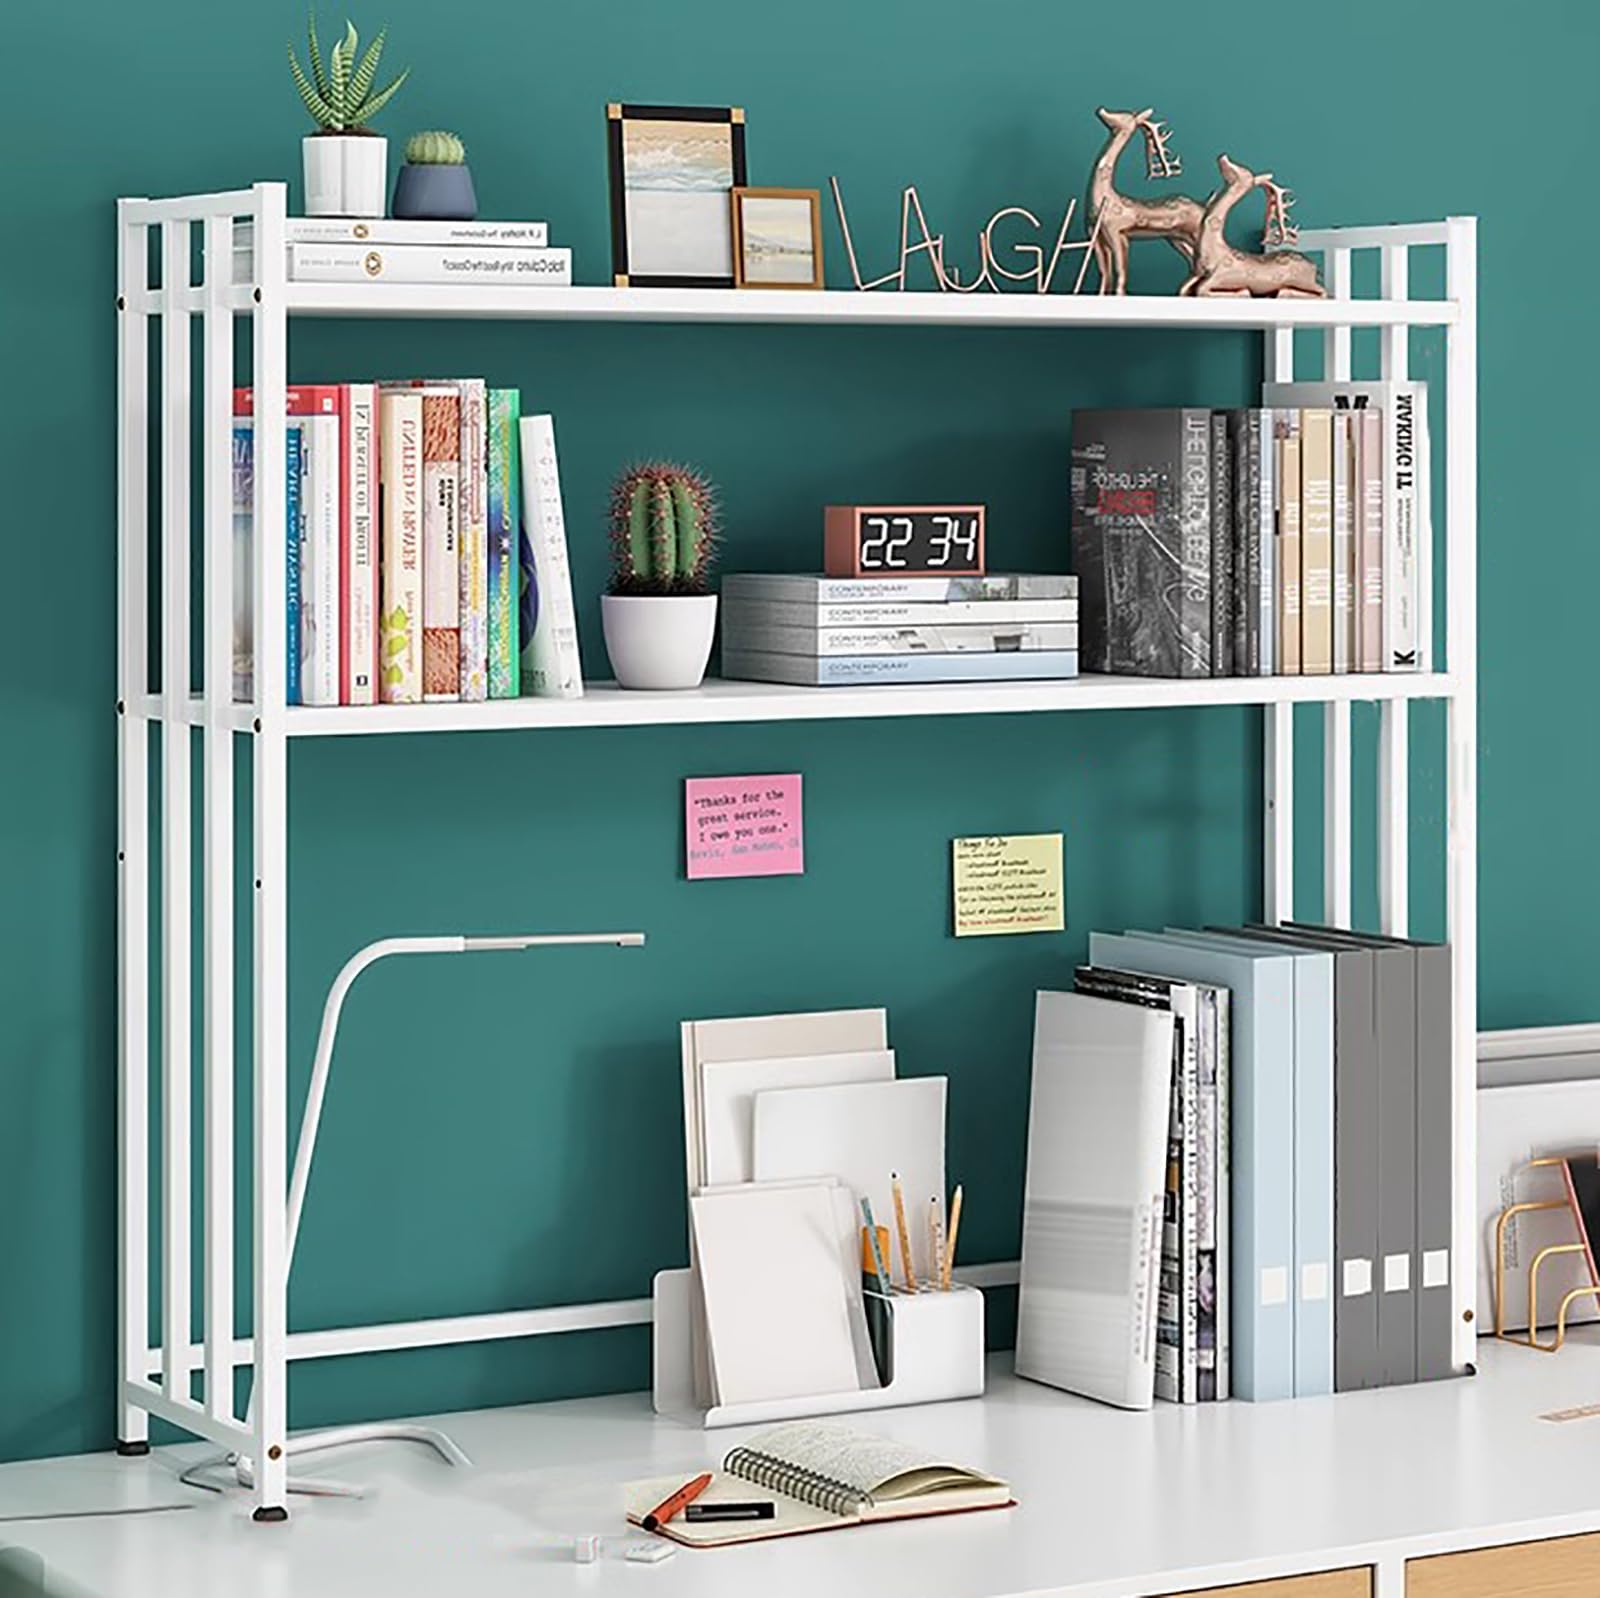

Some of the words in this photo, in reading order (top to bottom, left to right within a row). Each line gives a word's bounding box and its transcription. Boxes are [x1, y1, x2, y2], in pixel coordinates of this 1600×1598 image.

[861, 517, 913, 568] 22
[927, 516, 978, 566] 34
[742, 792, 760, 804] for
